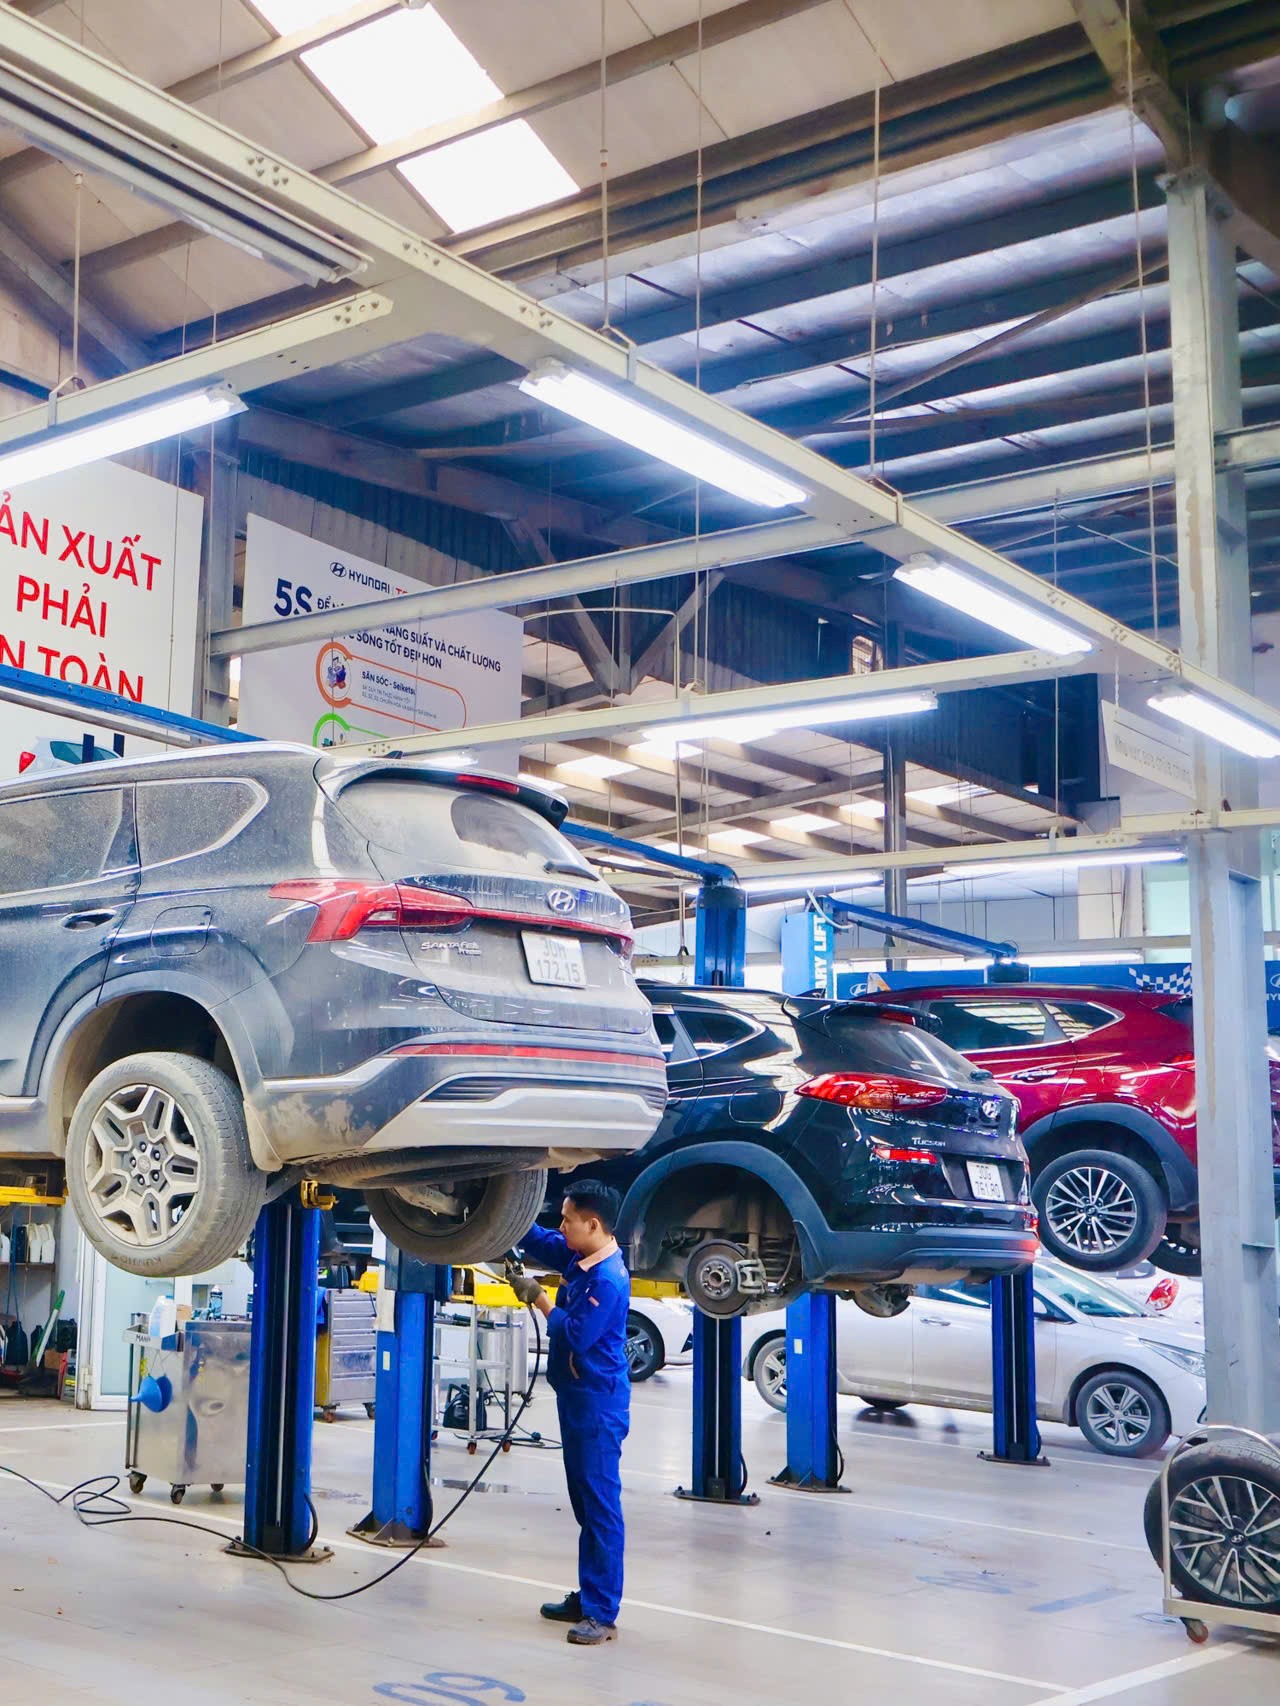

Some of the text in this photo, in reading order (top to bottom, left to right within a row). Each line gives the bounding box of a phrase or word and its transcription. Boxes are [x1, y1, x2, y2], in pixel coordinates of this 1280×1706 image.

[58, 525, 162, 591] XUẤT
[273, 578, 313, 617] 5S
[348, 569, 390, 594] HYUNDAI
[16, 575, 107, 637] PHẢI
[385, 637, 402, 656] TỐT
[410, 628, 433, 648] SUẤT
[434, 638, 447, 652] VÀ
[448, 643, 471, 662] CHẤT
[472, 652, 501, 672] LƯỢNG
[38, 646, 144, 703] TOÀN
[376, 674, 389, 686] SÓC
[813, 914, 827, 952] LIFT
[537, 959, 581, 983] 172.15
[911, 1137, 946, 1147] TUCSON
